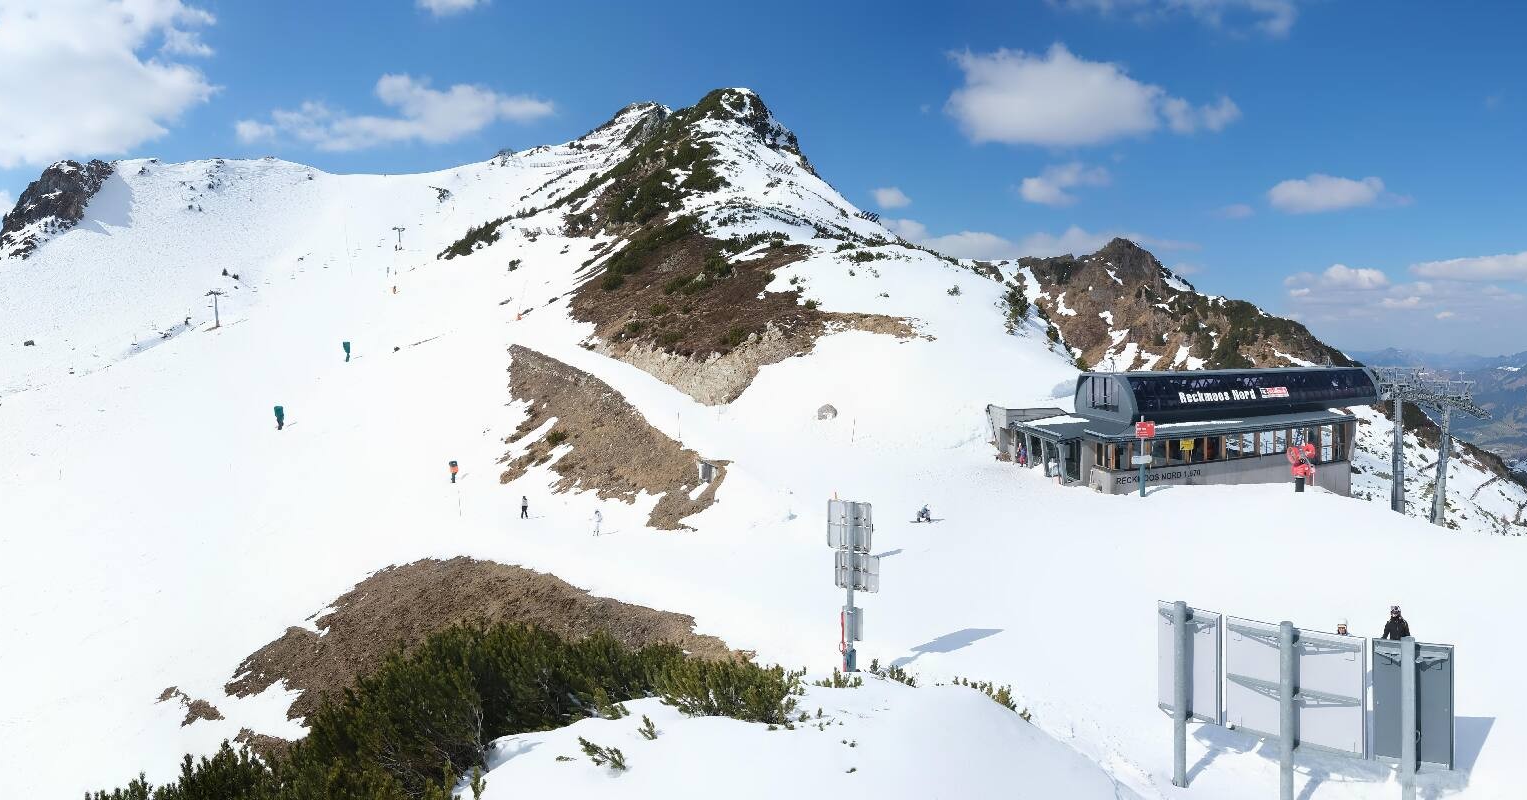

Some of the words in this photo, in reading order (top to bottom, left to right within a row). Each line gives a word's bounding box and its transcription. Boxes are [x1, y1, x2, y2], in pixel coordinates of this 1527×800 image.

[1178, 390, 1230, 404] Reckmoos
[1232, 388, 1257, 401] Nord
[1116, 473, 1160, 485] RECKOOS
[1161, 471, 1182, 480] NORD
